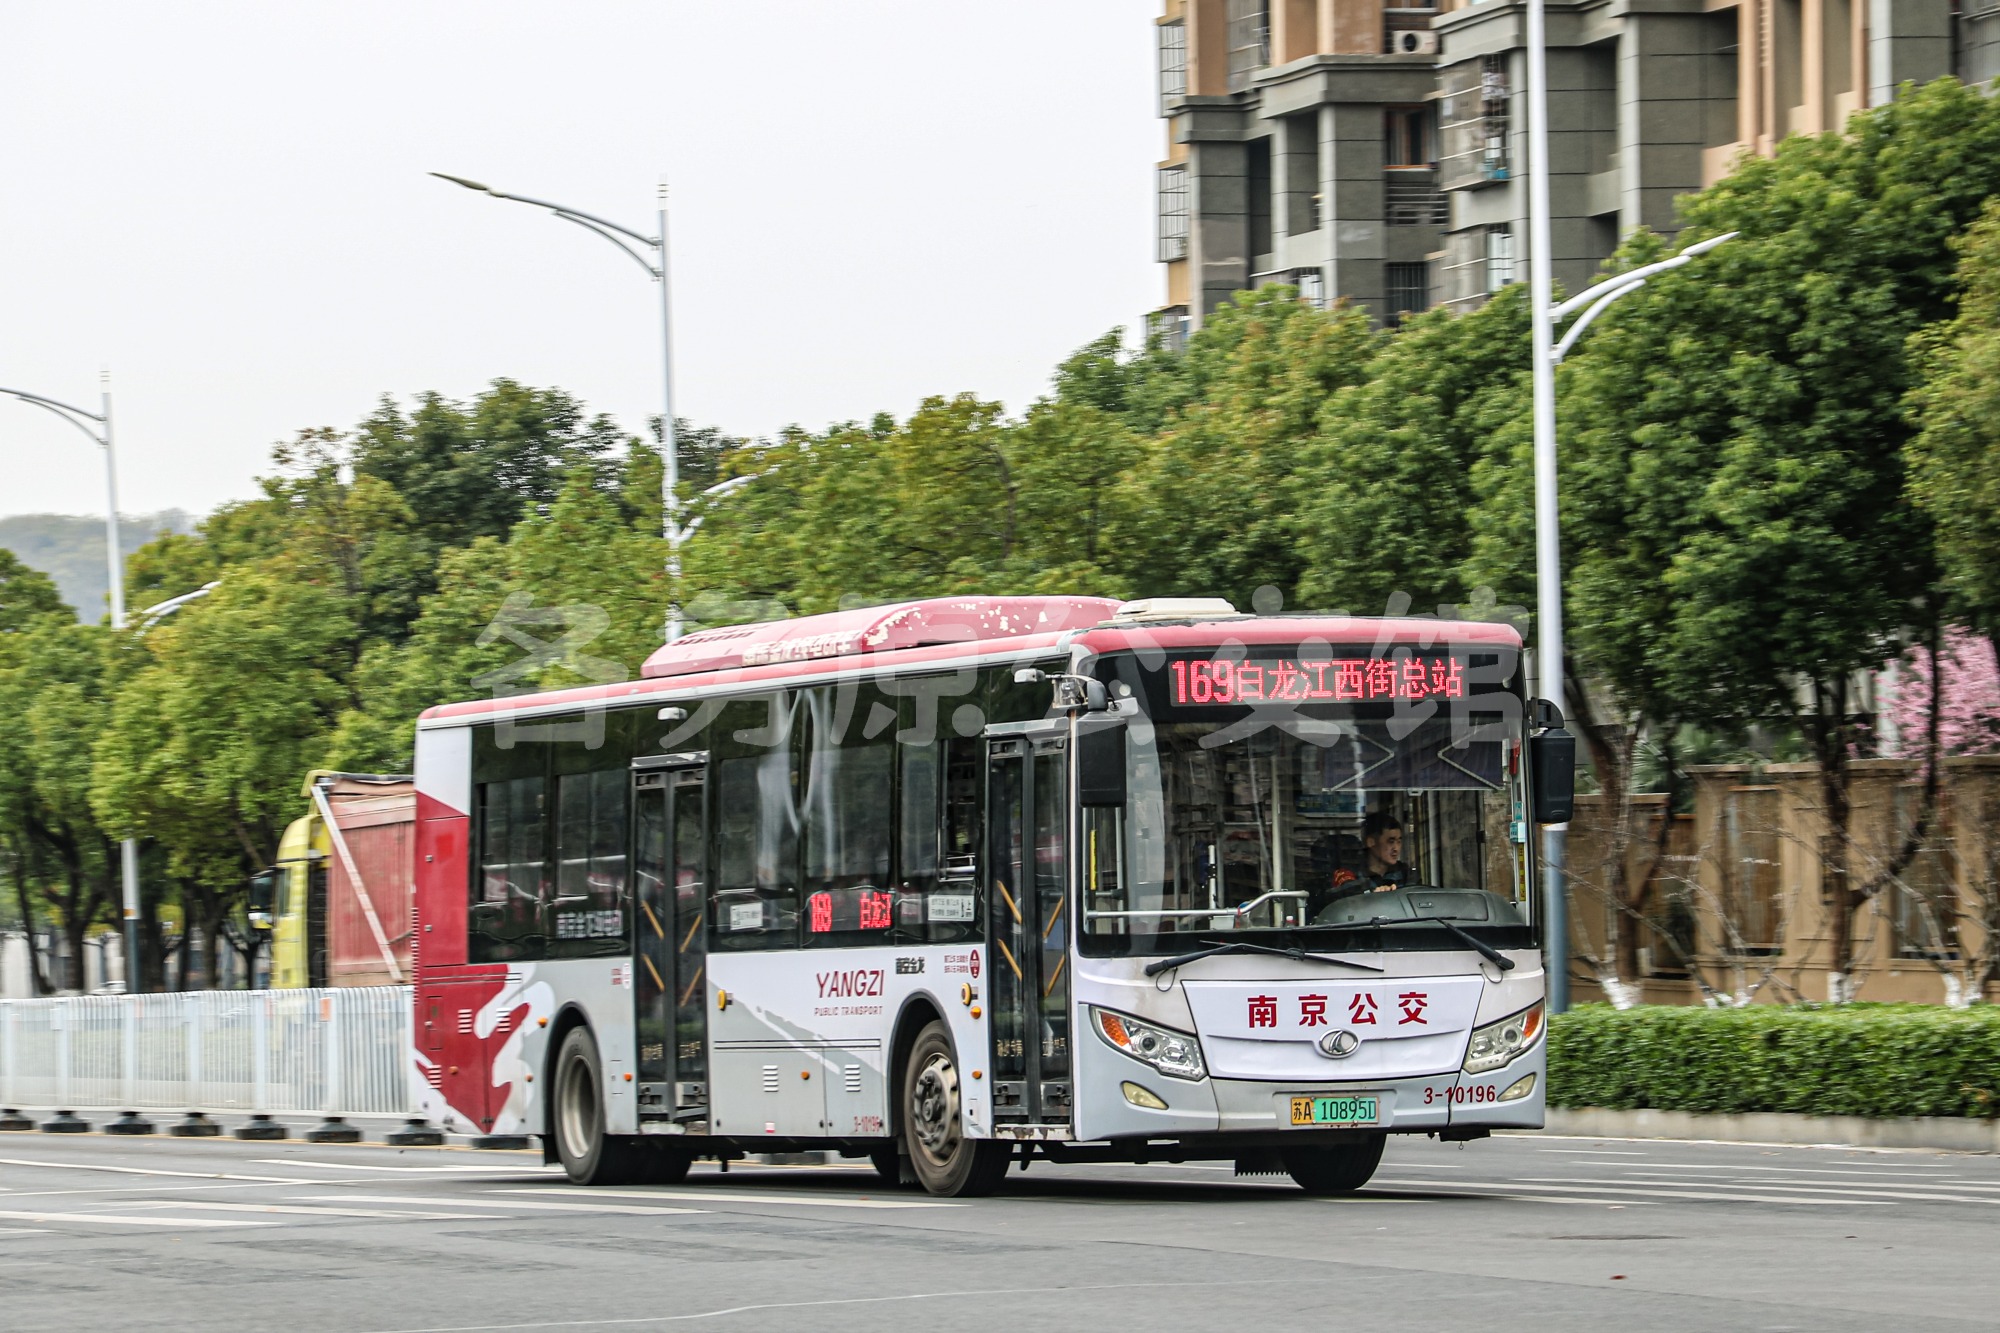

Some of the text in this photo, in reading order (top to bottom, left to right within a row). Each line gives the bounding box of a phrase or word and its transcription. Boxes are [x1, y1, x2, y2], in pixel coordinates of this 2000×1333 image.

[816, 969, 885, 998] YANGZI
[813, 1005, 883, 1017] PUBLIC TRANSPORT
[1247, 991, 1428, 1029] 南京公交
[1423, 1084, 1496, 1105] 3-10196
